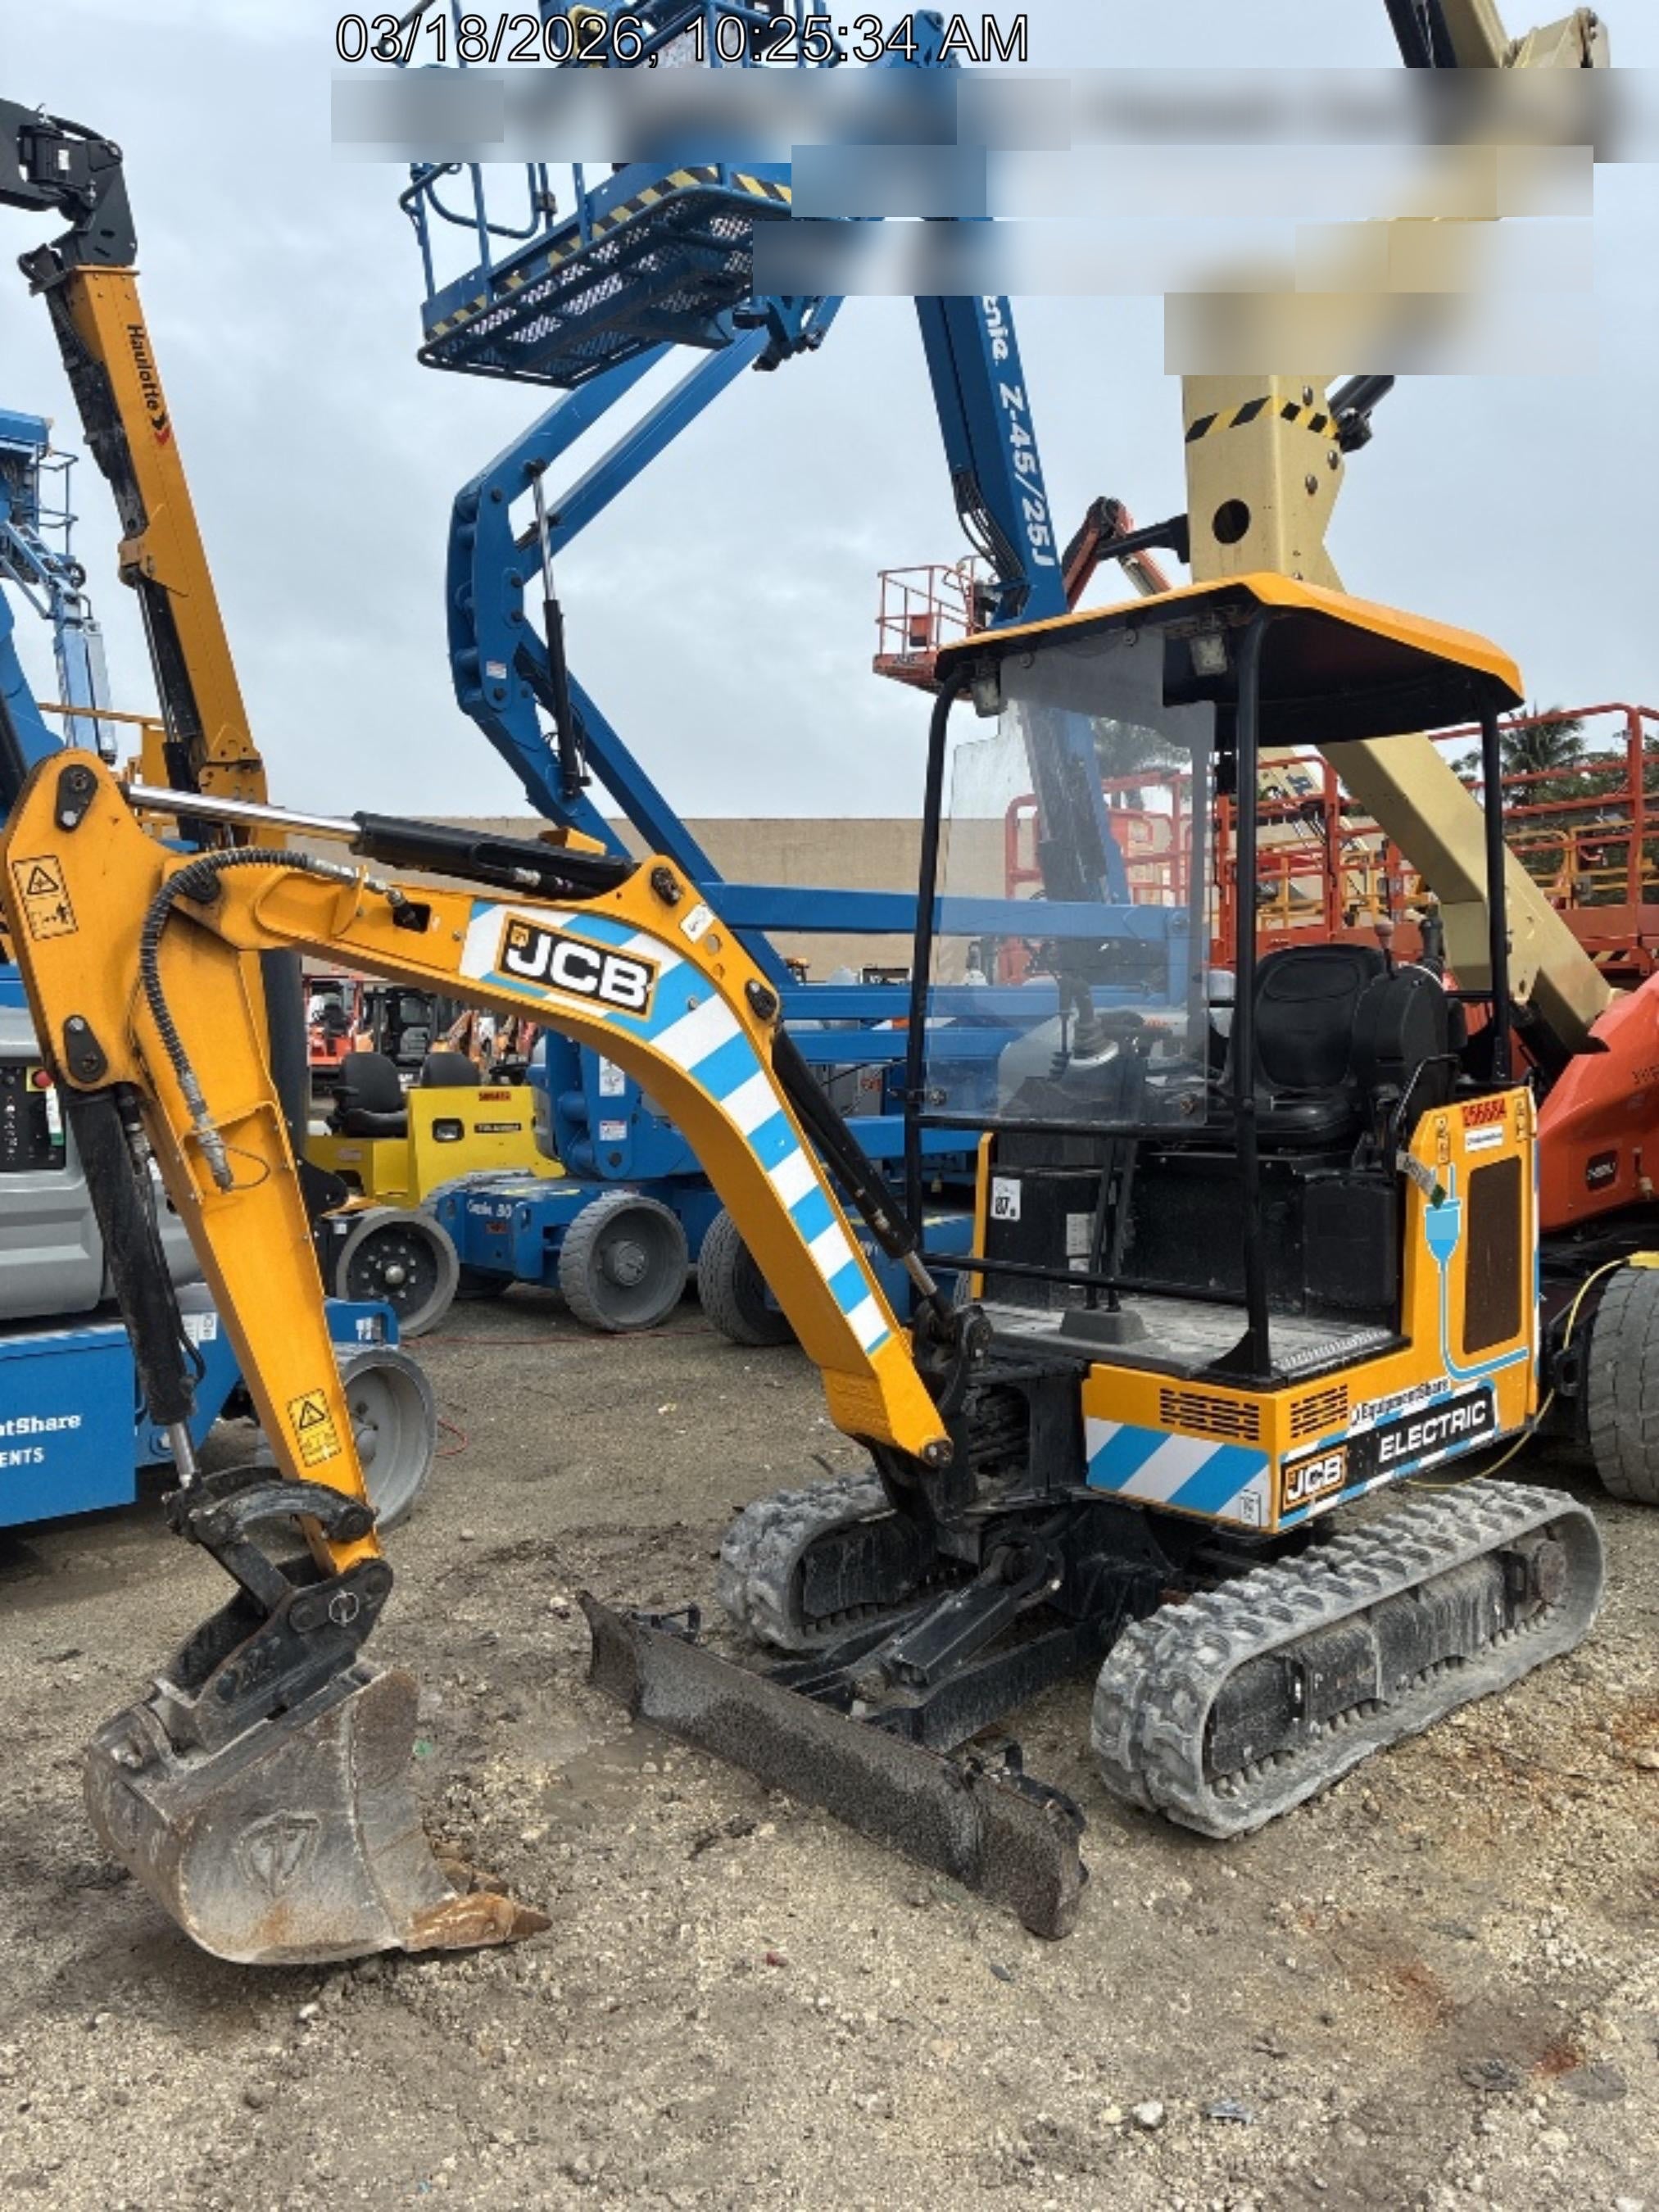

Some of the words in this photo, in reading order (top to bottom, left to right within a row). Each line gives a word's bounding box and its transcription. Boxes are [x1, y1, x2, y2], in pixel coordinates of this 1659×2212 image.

[127, 324, 160, 410] Haulotte
[982, 296, 1009, 360] enie
[999, 383, 1054, 566] Z-45/25J
[505, 933, 648, 1009] JCB
[1379, 1399, 1487, 1463] ELECTRIC
[1286, 1454, 1342, 1500] JCB
